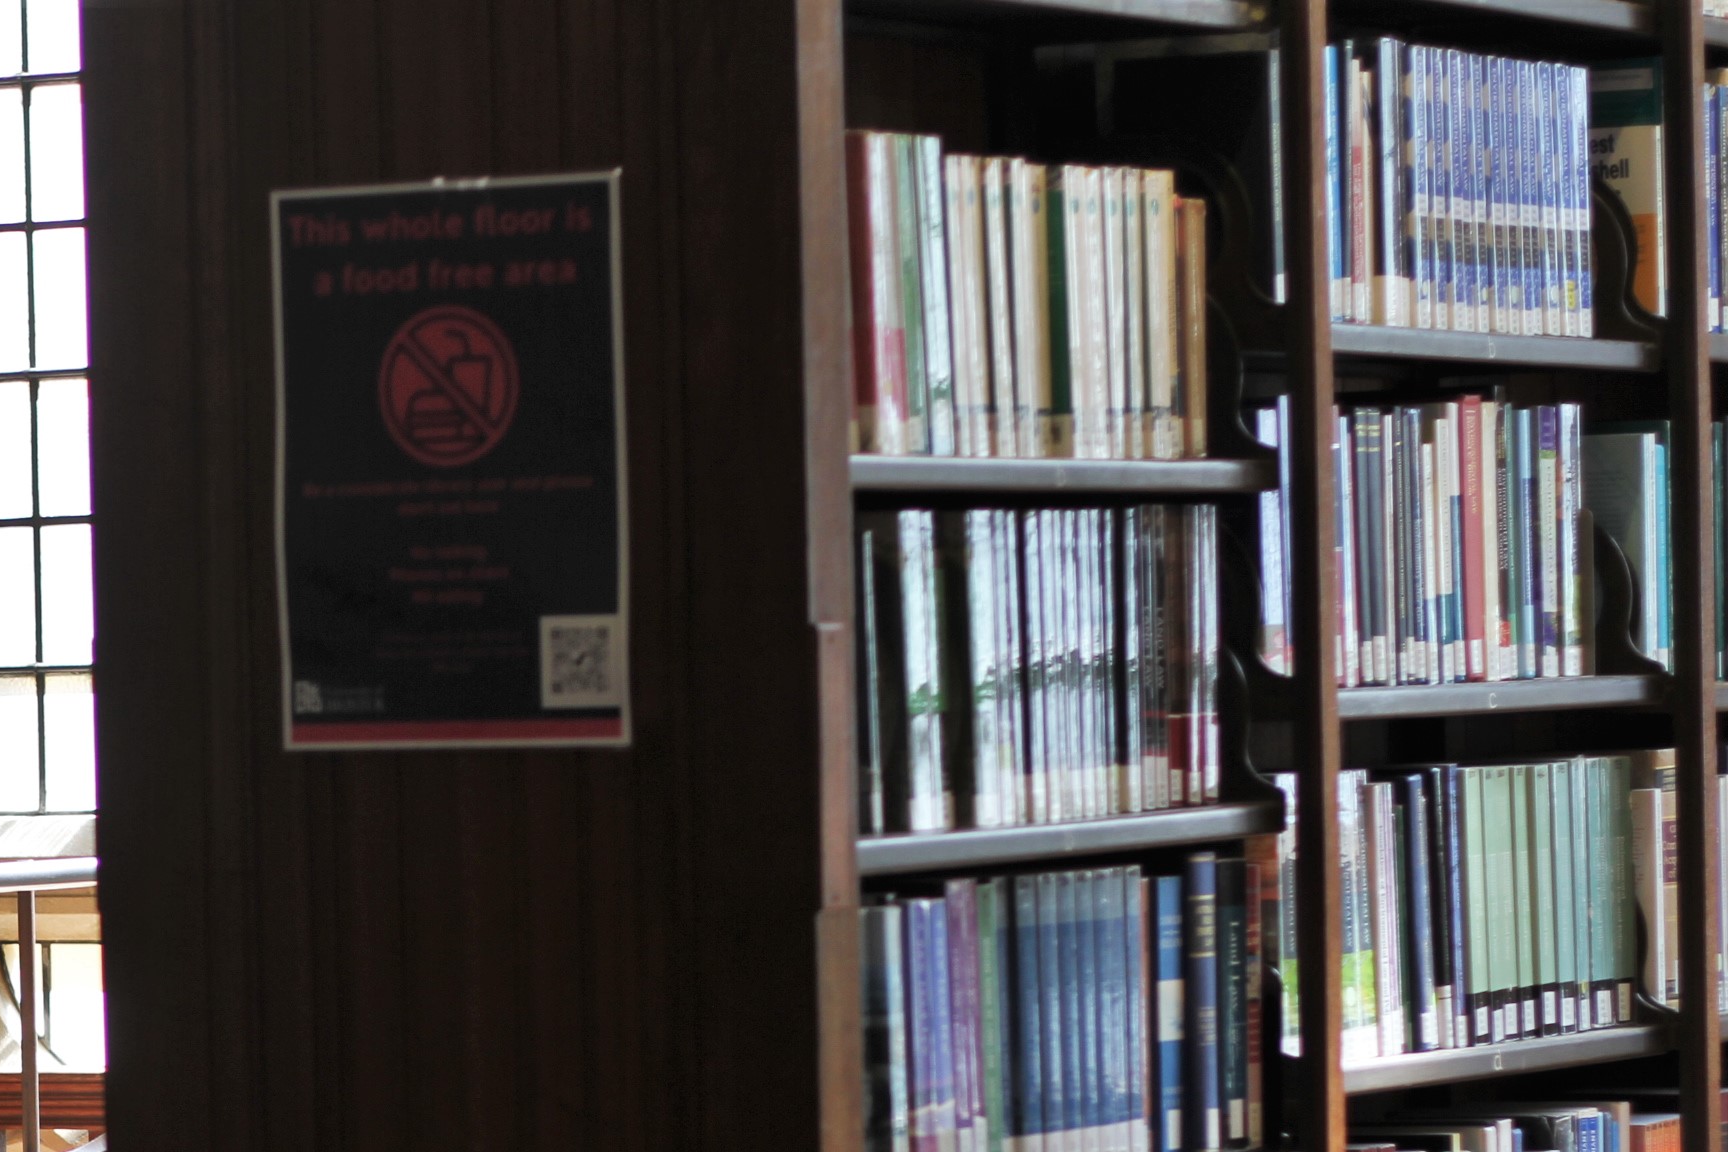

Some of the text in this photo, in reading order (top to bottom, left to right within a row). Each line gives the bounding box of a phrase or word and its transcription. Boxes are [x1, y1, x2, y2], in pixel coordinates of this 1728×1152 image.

[289, 199, 592, 248] This whole floor is
[313, 255, 578, 297] a food free area
[1229, 920, 1243, 967] Land
